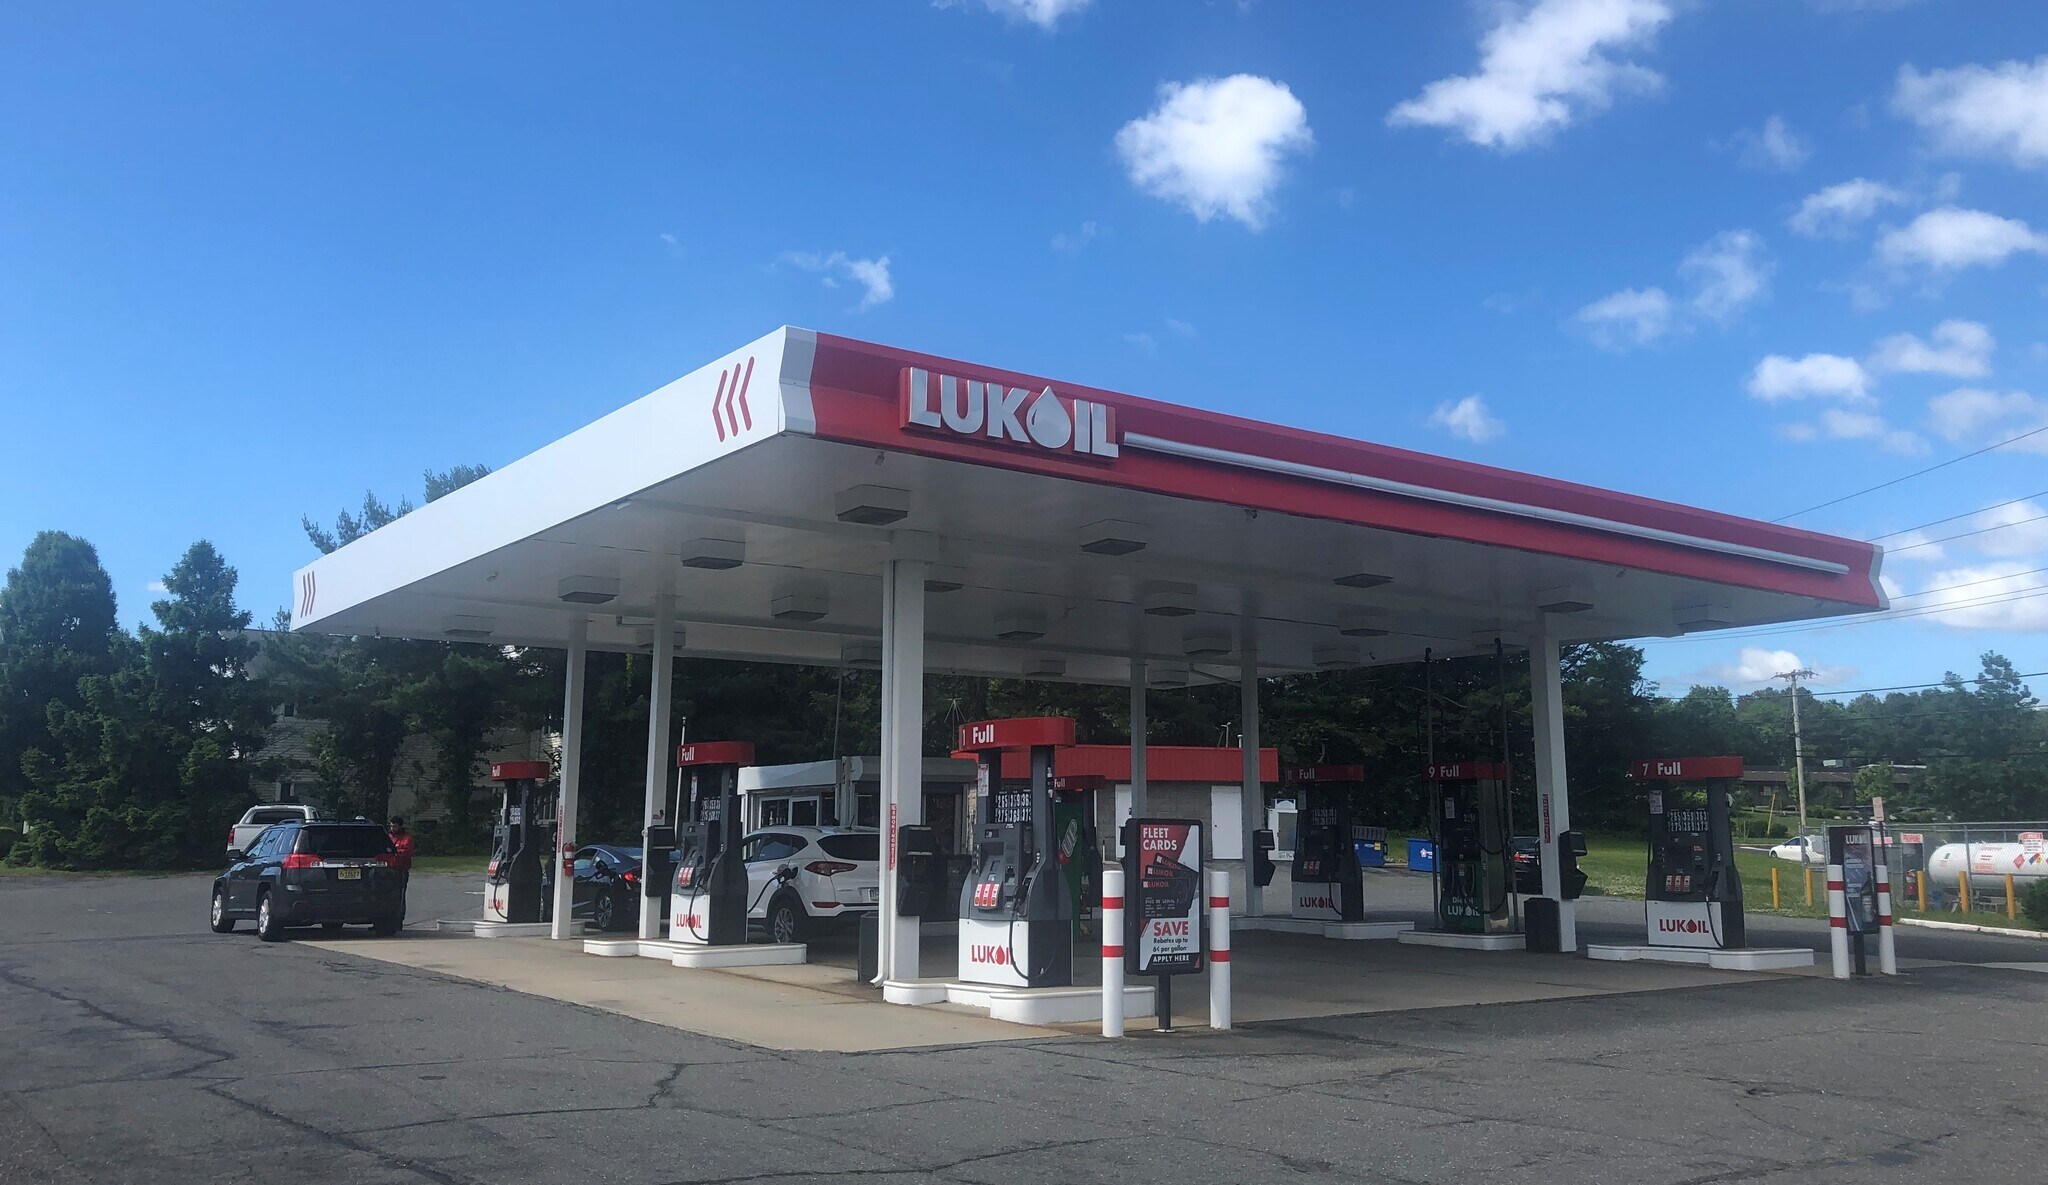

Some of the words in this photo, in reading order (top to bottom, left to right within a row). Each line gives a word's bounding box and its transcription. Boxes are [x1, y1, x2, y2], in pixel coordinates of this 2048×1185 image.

[909, 366, 1119, 458] LUKOIL
[972, 724, 994, 744] Full
[681, 746, 695, 762] Full
[1299, 767, 1316, 780] Full
[1428, 766, 1436, 778] 9
[1440, 764, 1460, 777] Full
[1642, 762, 1649, 776] 7
[1657, 761, 1681, 776] Full
[1143, 827, 1169, 839] FLEET
[1143, 839, 1178, 851] CARDS
[1153, 921, 1189, 937] SAVE
[1659, 919, 1710, 934] LUKOIL
[1152, 955, 1173, 963] APPLY
[1174, 954, 1190, 962] HERE
